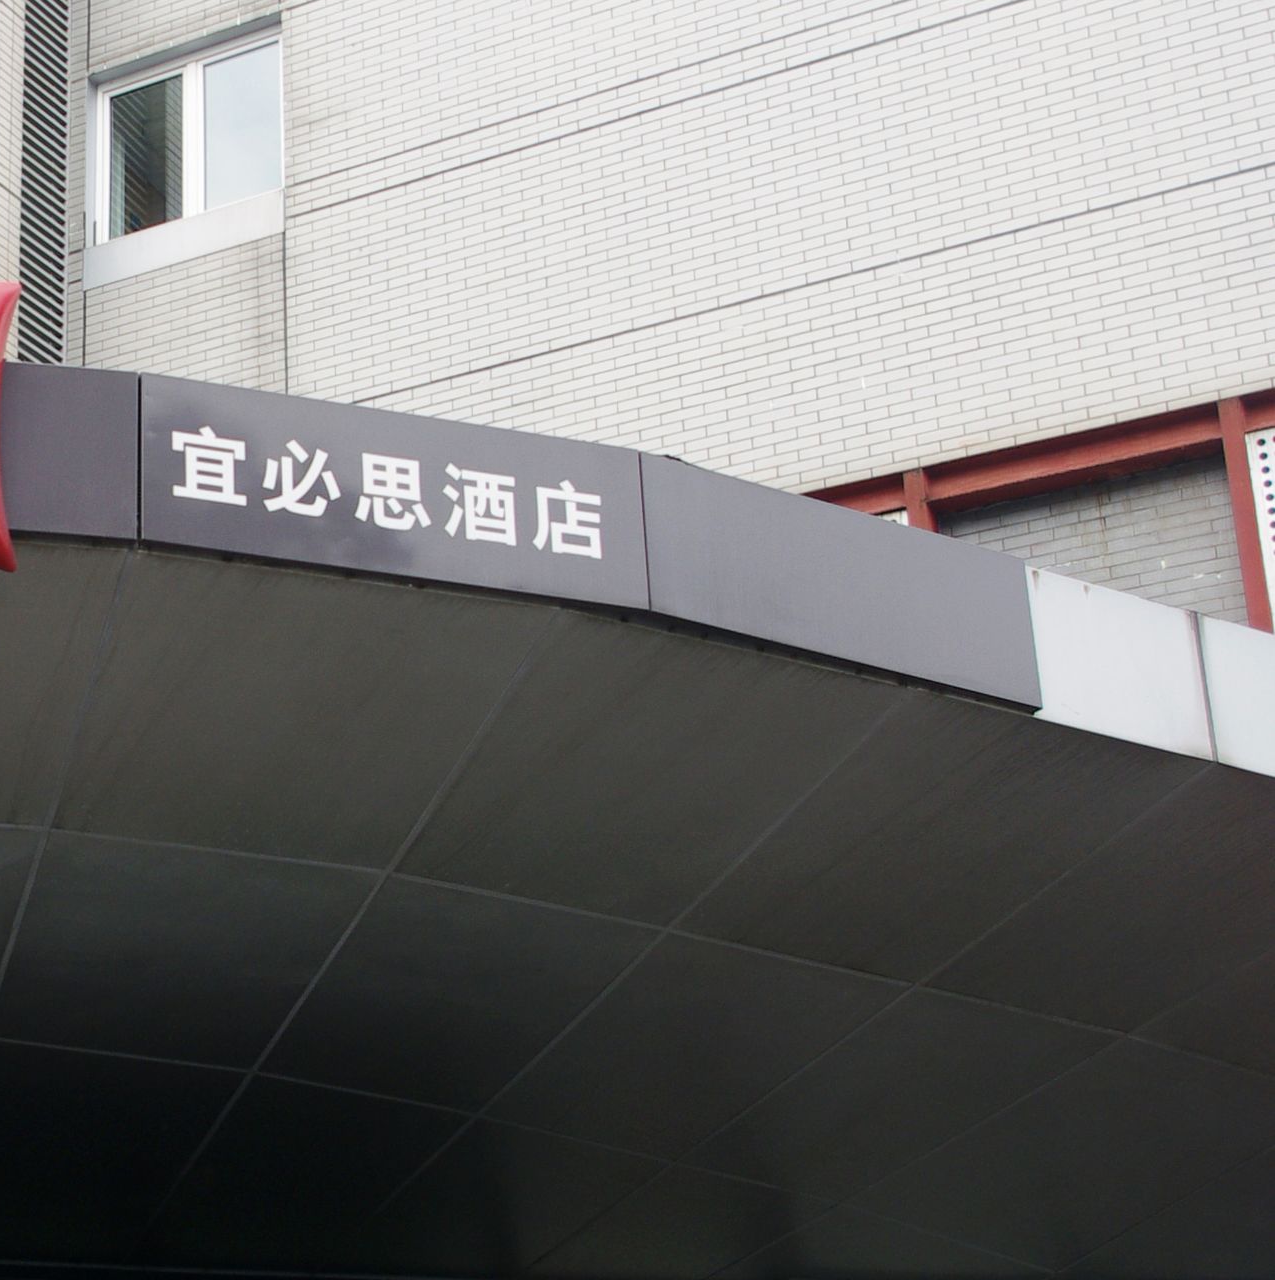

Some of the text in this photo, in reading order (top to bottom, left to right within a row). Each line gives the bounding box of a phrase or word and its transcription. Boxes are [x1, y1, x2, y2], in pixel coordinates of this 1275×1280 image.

[171, 426, 602, 559] 宜必思酒店
